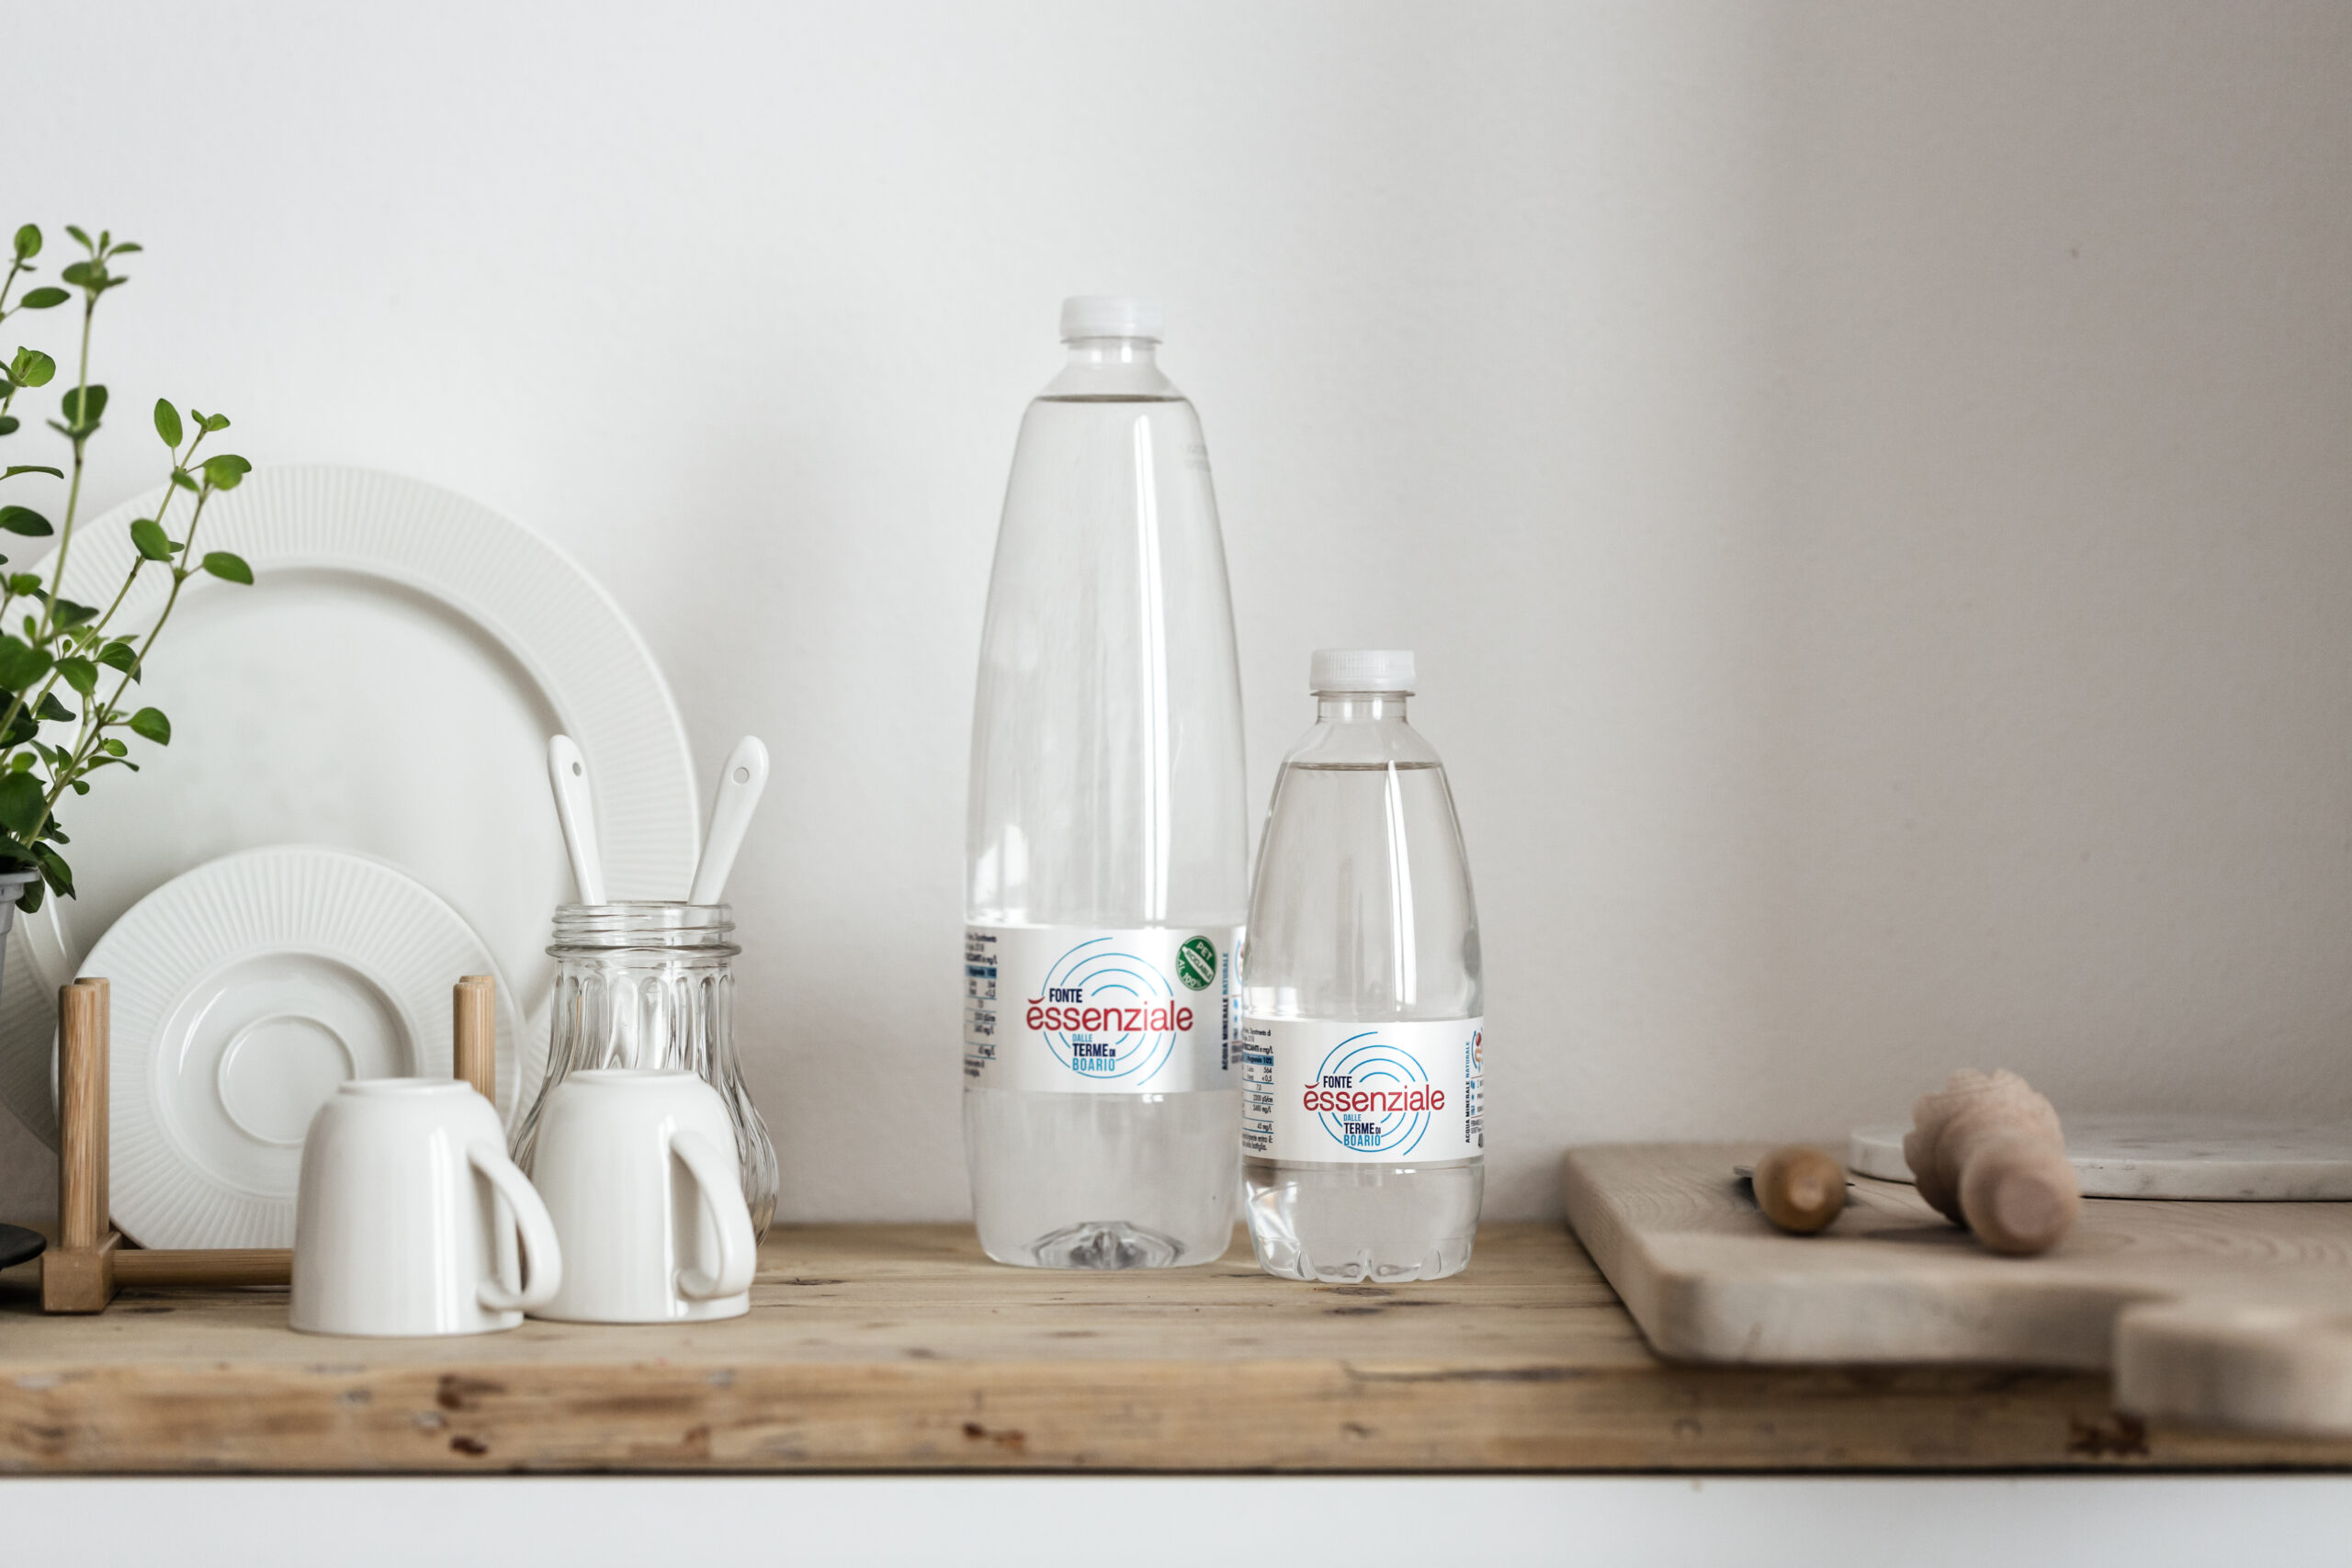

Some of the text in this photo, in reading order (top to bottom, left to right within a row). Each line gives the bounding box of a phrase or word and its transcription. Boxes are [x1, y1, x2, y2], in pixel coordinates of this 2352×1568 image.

[1196, 942, 1213, 960] PET
[1049, 987, 1083, 1003] FONTE
[1072, 1033, 1092, 1043] DALLE
[1072, 1043, 1109, 1057] TERME
[1072, 1057, 1115, 1072] BOARIO
[1323, 1076, 1352, 1089] FONTE
[1343, 1113, 1362, 1122] DALLE
[1343, 1122, 1375, 1134] TERME
[1343, 1134, 1381, 1146] BOARIO
